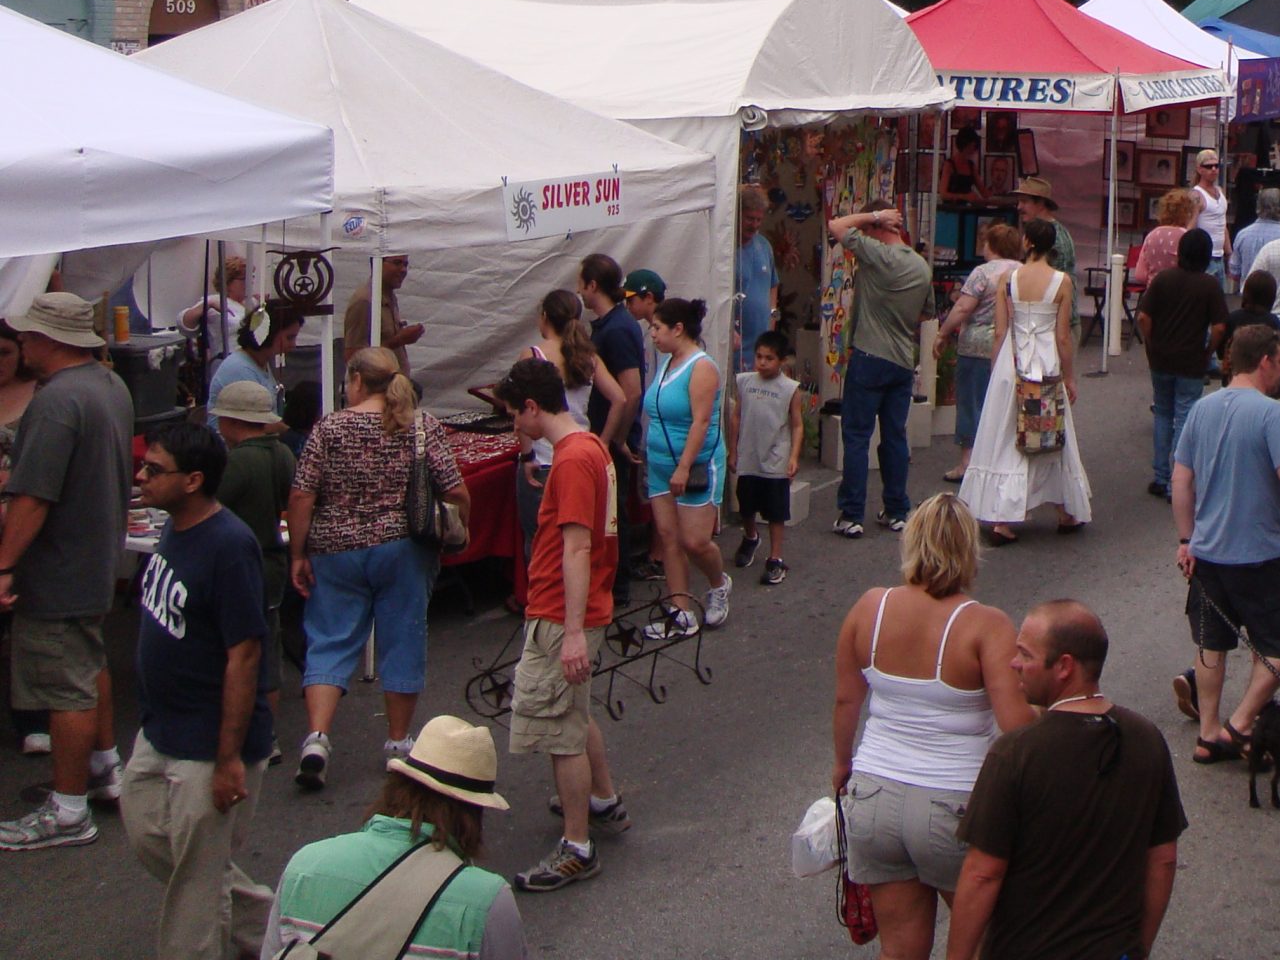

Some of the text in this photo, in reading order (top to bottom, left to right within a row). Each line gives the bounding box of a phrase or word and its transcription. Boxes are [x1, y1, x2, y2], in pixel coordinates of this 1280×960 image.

[166, 0, 196, 14] 509
[936, 75, 1225, 104] TURES CARICATURES
[542, 178, 620, 210] SILVER SUN
[608, 205, 619, 216] 925
